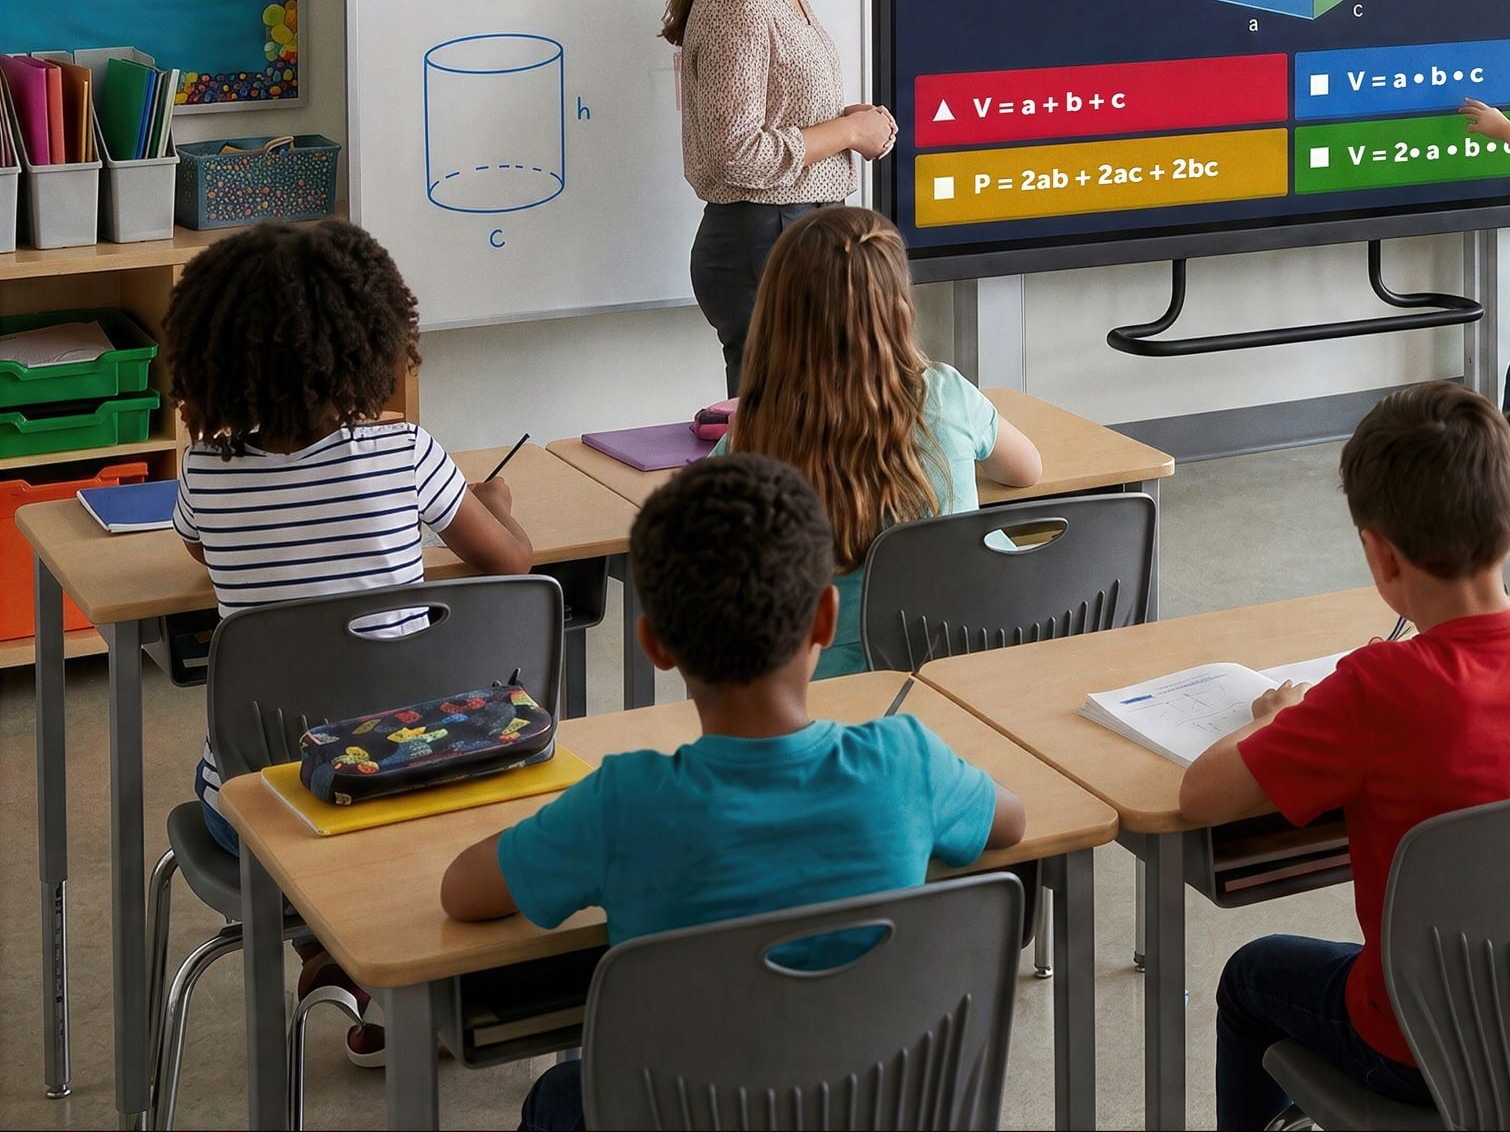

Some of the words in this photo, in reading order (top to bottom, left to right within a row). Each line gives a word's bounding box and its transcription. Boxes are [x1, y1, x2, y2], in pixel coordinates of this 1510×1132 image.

[1353, 4, 1363, 17] c
[1249, 19, 1259, 32] a
[578, 96, 590, 119] h
[1021, 169, 1069, 191] 2ab
[1098, 164, 1143, 185] 2ac
[1172, 158, 1219, 179] 2bc
